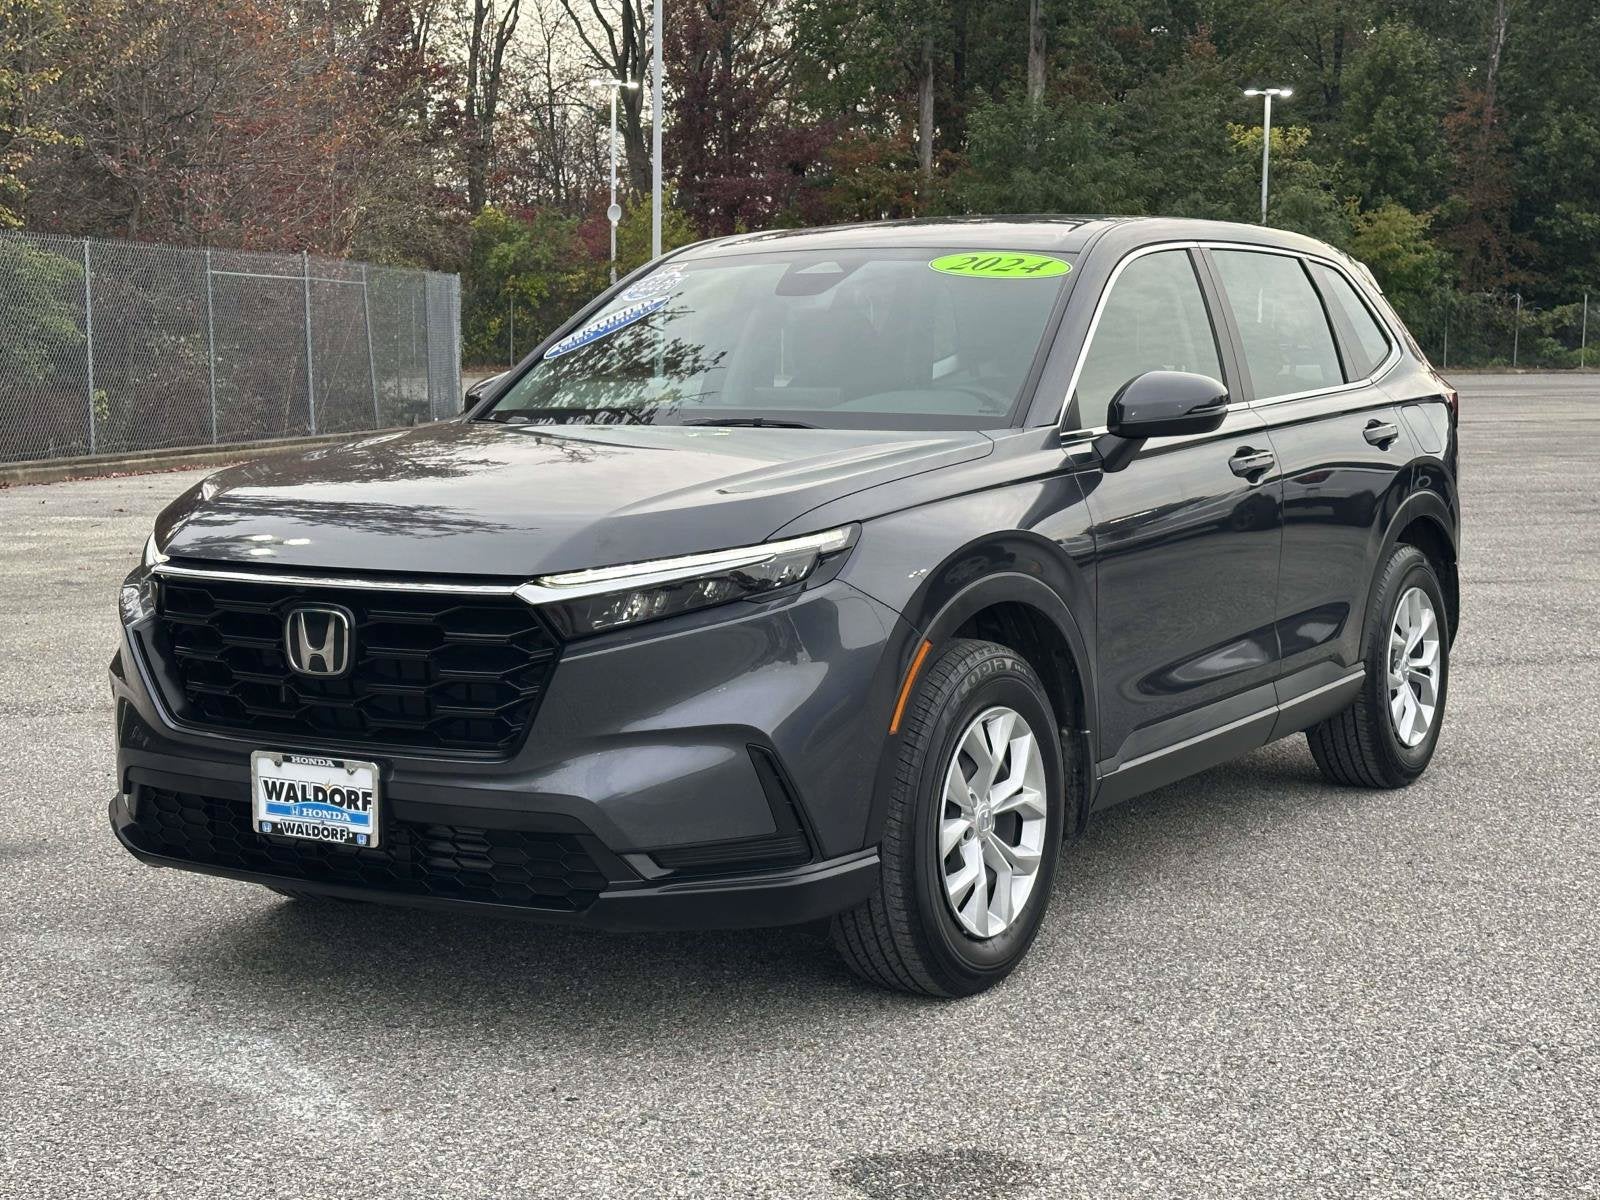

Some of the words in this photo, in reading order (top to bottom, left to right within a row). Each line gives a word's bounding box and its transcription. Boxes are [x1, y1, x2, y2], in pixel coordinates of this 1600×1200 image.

[946, 256, 1054, 274] 2024
[290, 755, 335, 767] HONDA
[262, 779, 372, 812] WALDORF
[302, 807, 351, 822] HONDA
[282, 821, 348, 841] WALDORF
